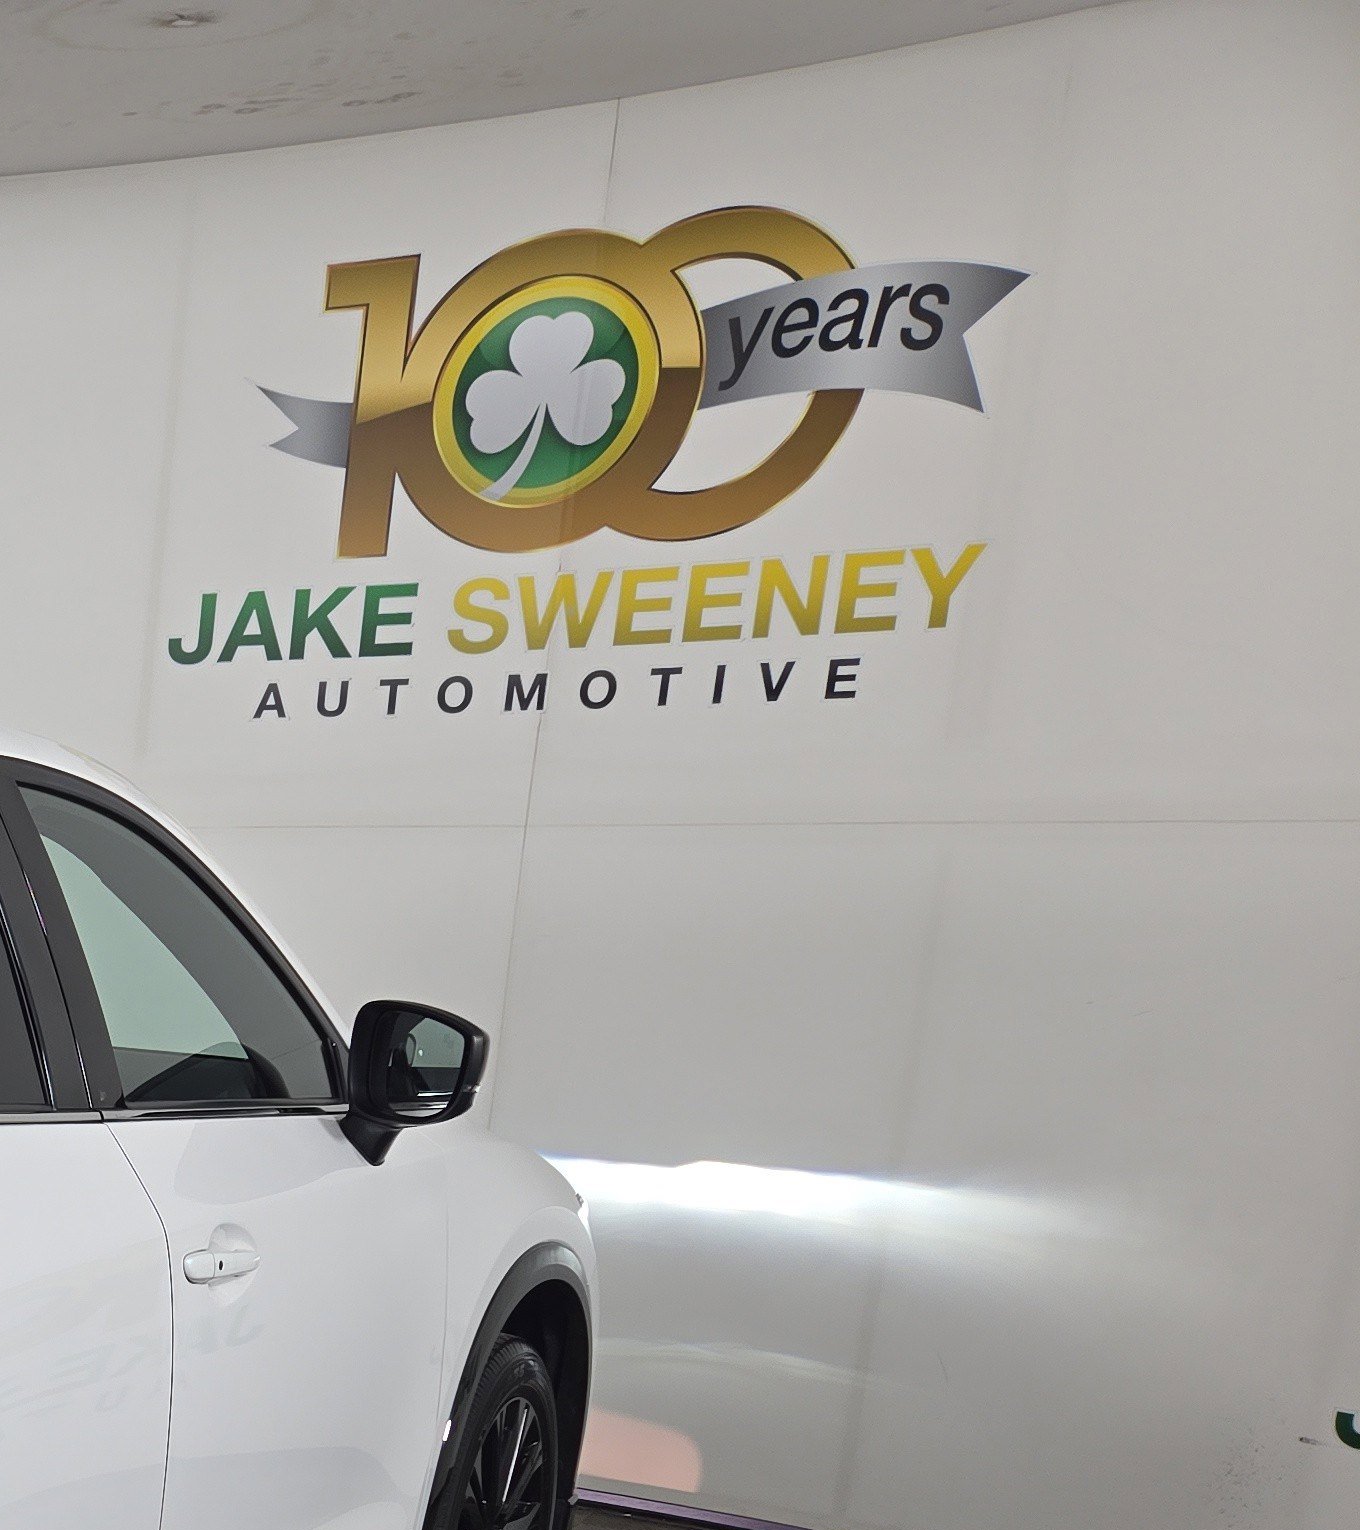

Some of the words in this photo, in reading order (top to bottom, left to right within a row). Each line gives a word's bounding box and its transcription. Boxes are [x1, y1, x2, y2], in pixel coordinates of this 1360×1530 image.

[716, 278, 951, 390] years
[167, 581, 420, 666] JAKE
[446, 542, 988, 654] SWEENEY
[252, 656, 863, 720] AUTOMOTIVE
